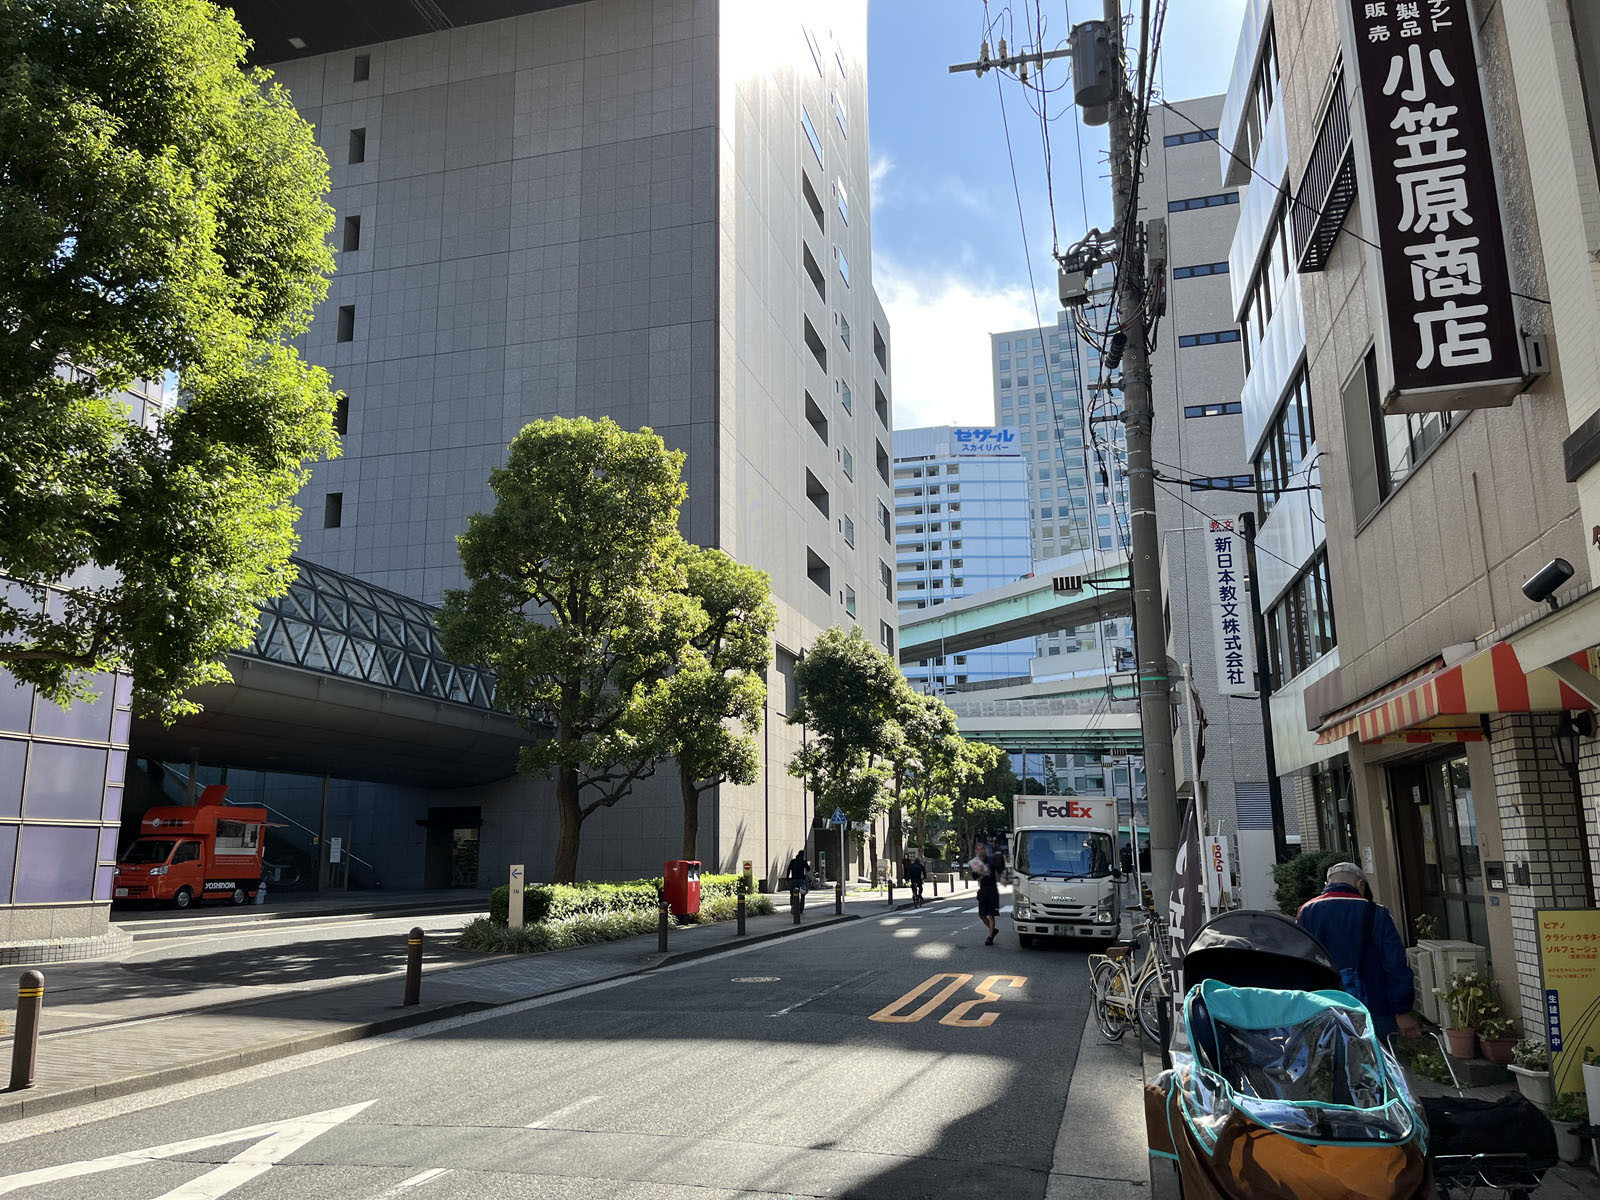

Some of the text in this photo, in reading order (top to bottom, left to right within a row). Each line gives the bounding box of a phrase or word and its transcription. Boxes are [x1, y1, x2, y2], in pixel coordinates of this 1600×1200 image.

[1364, 2, 1391, 43] 販売
[1395, 2, 1422, 38] 製品
[1382, 43, 1492, 370] 小笠原商店
[954, 429, 1015, 442] セザール
[962, 444, 1009, 452] スカイリバー
[1214, 537, 1246, 685] 新日本教文株式会社
[1038, 801, 1093, 819] FedEx
[1215, 844, 1224, 872] DyDo
[1546, 945, 1598, 953] ソルフェージュ
[867, 973, 1029, 1027] 30
